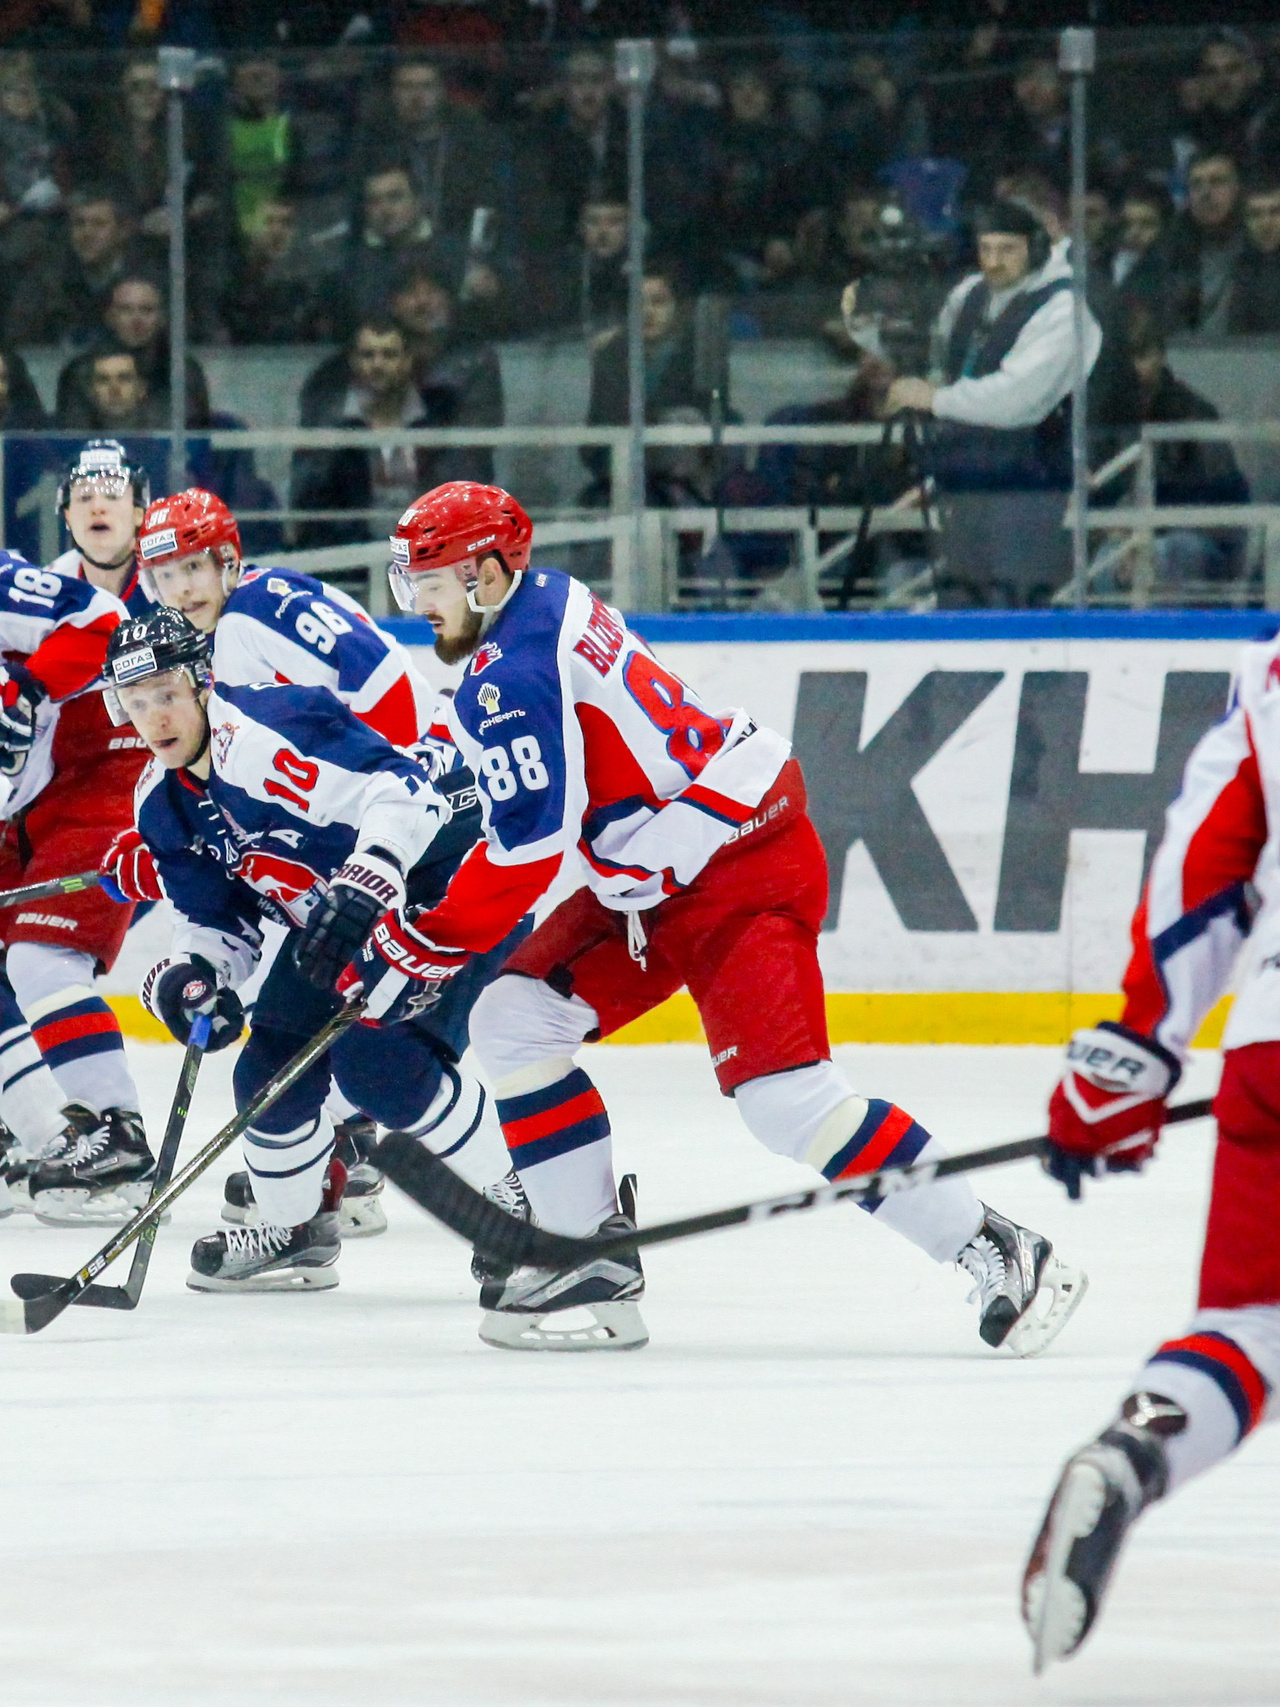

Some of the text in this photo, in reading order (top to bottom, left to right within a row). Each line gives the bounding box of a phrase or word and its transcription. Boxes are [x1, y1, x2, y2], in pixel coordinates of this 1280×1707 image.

[141, 533, 173, 549] СОГАЗ
[8, 567, 62, 608] 18
[119, 623, 148, 647] 10
[295, 601, 353, 655] 96
[114, 651, 153, 672] СОГАЗ
[263, 748, 320, 813] 10
[481, 735, 549, 802] 88
[268, 828, 304, 850] A
[373, 922, 465, 979] BAUER
